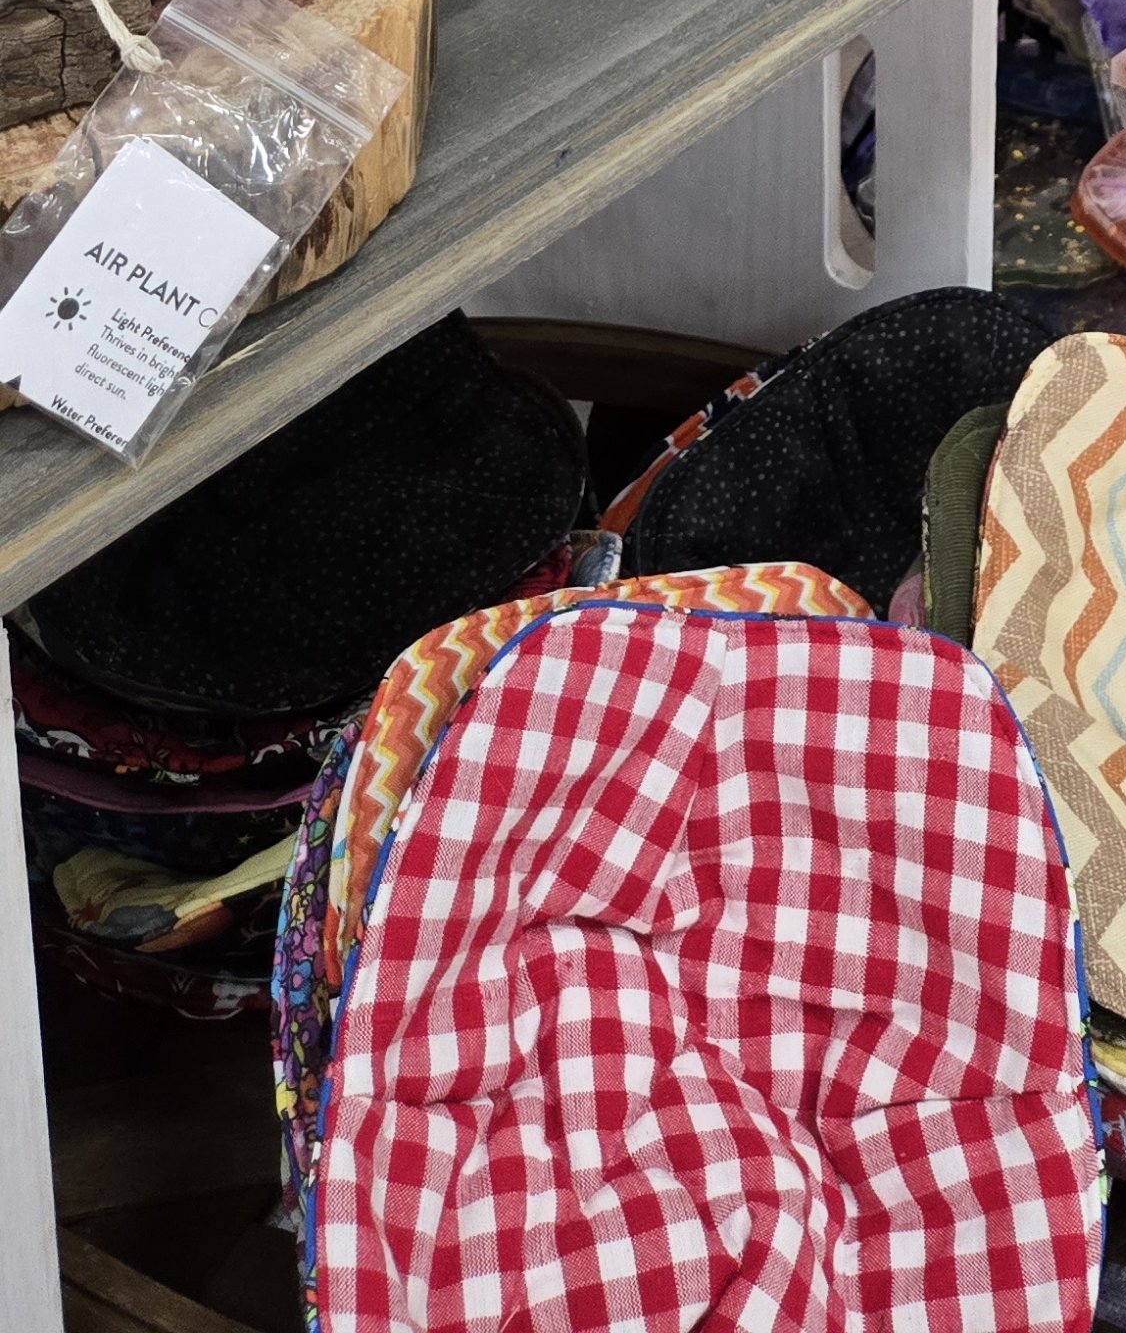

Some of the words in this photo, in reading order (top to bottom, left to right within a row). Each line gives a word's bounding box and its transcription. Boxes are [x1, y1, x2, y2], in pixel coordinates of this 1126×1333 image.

[84, 241, 129, 276] AIR
[126, 263, 201, 317] PLANT
[111, 308, 141, 333] Light
[100, 325, 136, 356] Thrives
[136, 347, 148, 362] in
[75, 363, 106, 387] direct
[106, 382, 126, 400] sun.
[87, 342, 146, 385] fluorescent
[50, 394, 84, 423] Water
